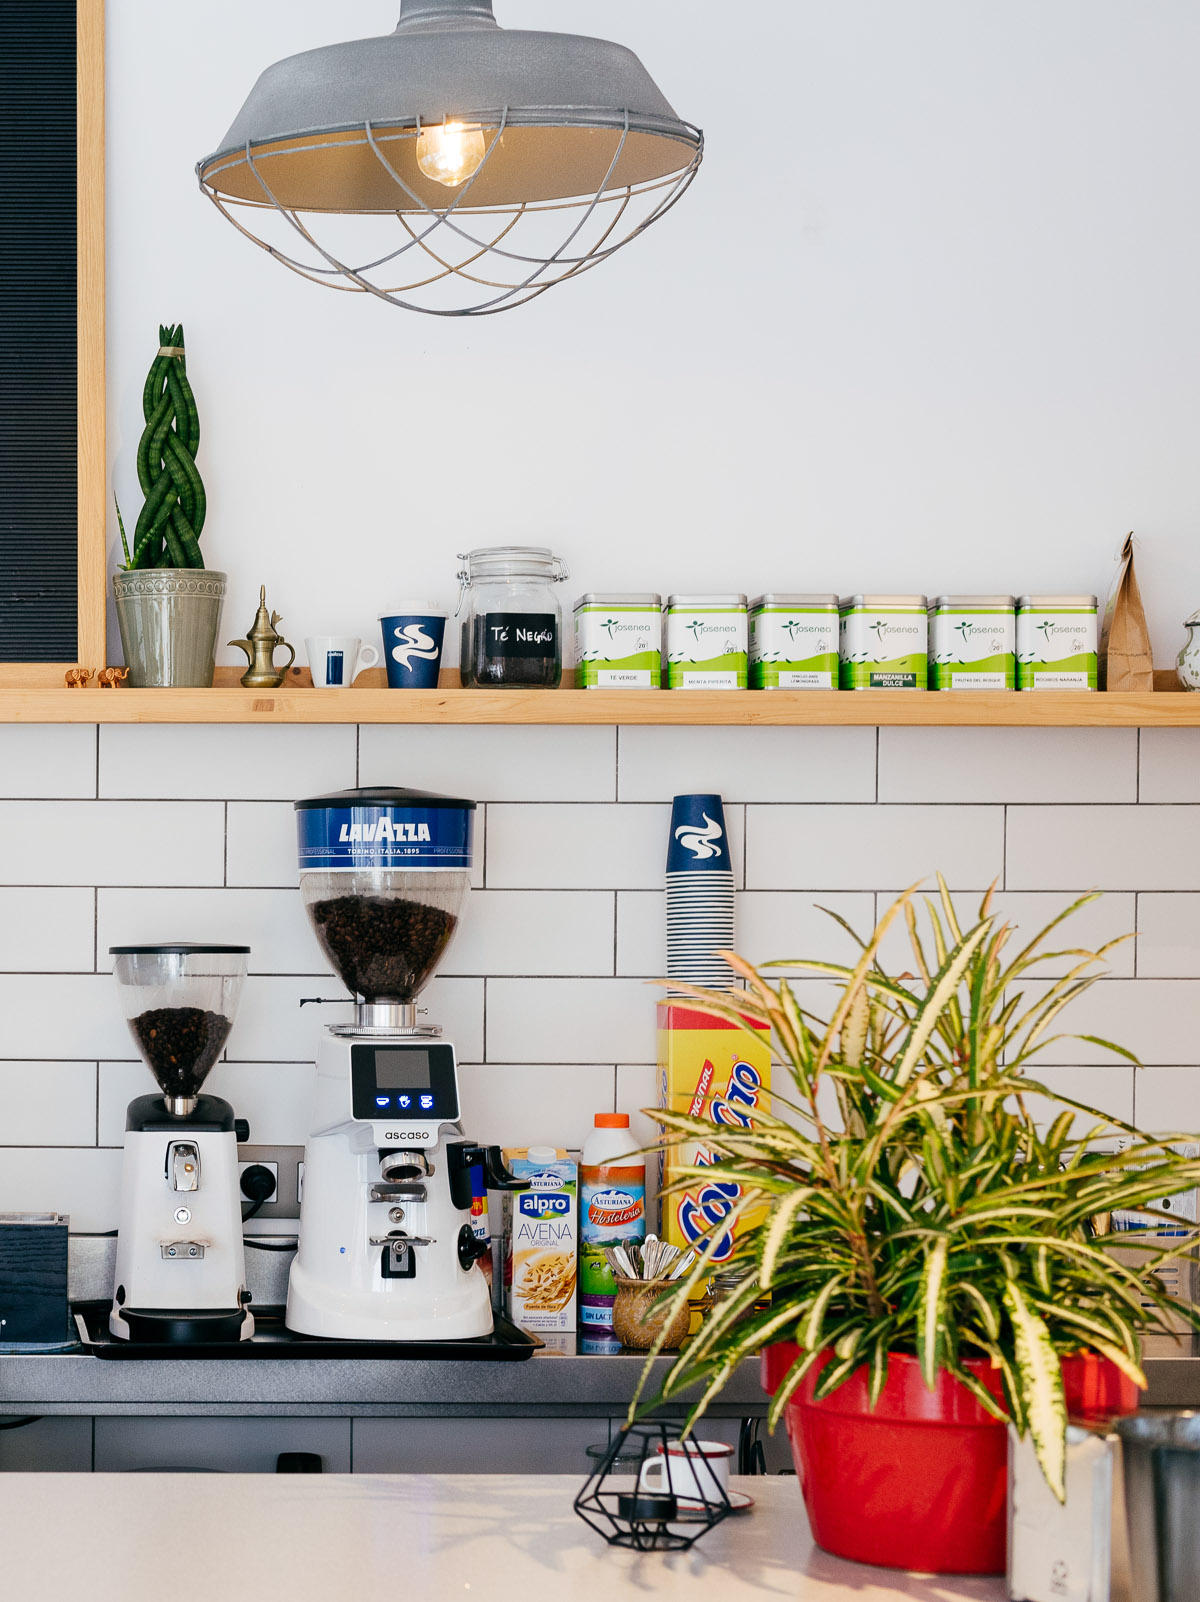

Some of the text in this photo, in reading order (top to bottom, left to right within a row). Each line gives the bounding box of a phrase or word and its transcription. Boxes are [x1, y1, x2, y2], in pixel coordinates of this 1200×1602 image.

[491, 626, 509, 640] Té
[614, 623, 650, 633] josenea
[700, 625, 737, 635] josenea
[795, 625, 831, 635] josenea
[883, 625, 919, 635] josenea
[968, 625, 1004, 635] josenea
[1051, 625, 1087, 635] josenea
[339, 817, 430, 842] LAVAZZA
[384, 1131, 429, 1140] ascaso
[523, 1195, 566, 1214] alpro
[593, 1197, 632, 1205] ASTURIANA
[517, 1223, 572, 1240] AVENA
